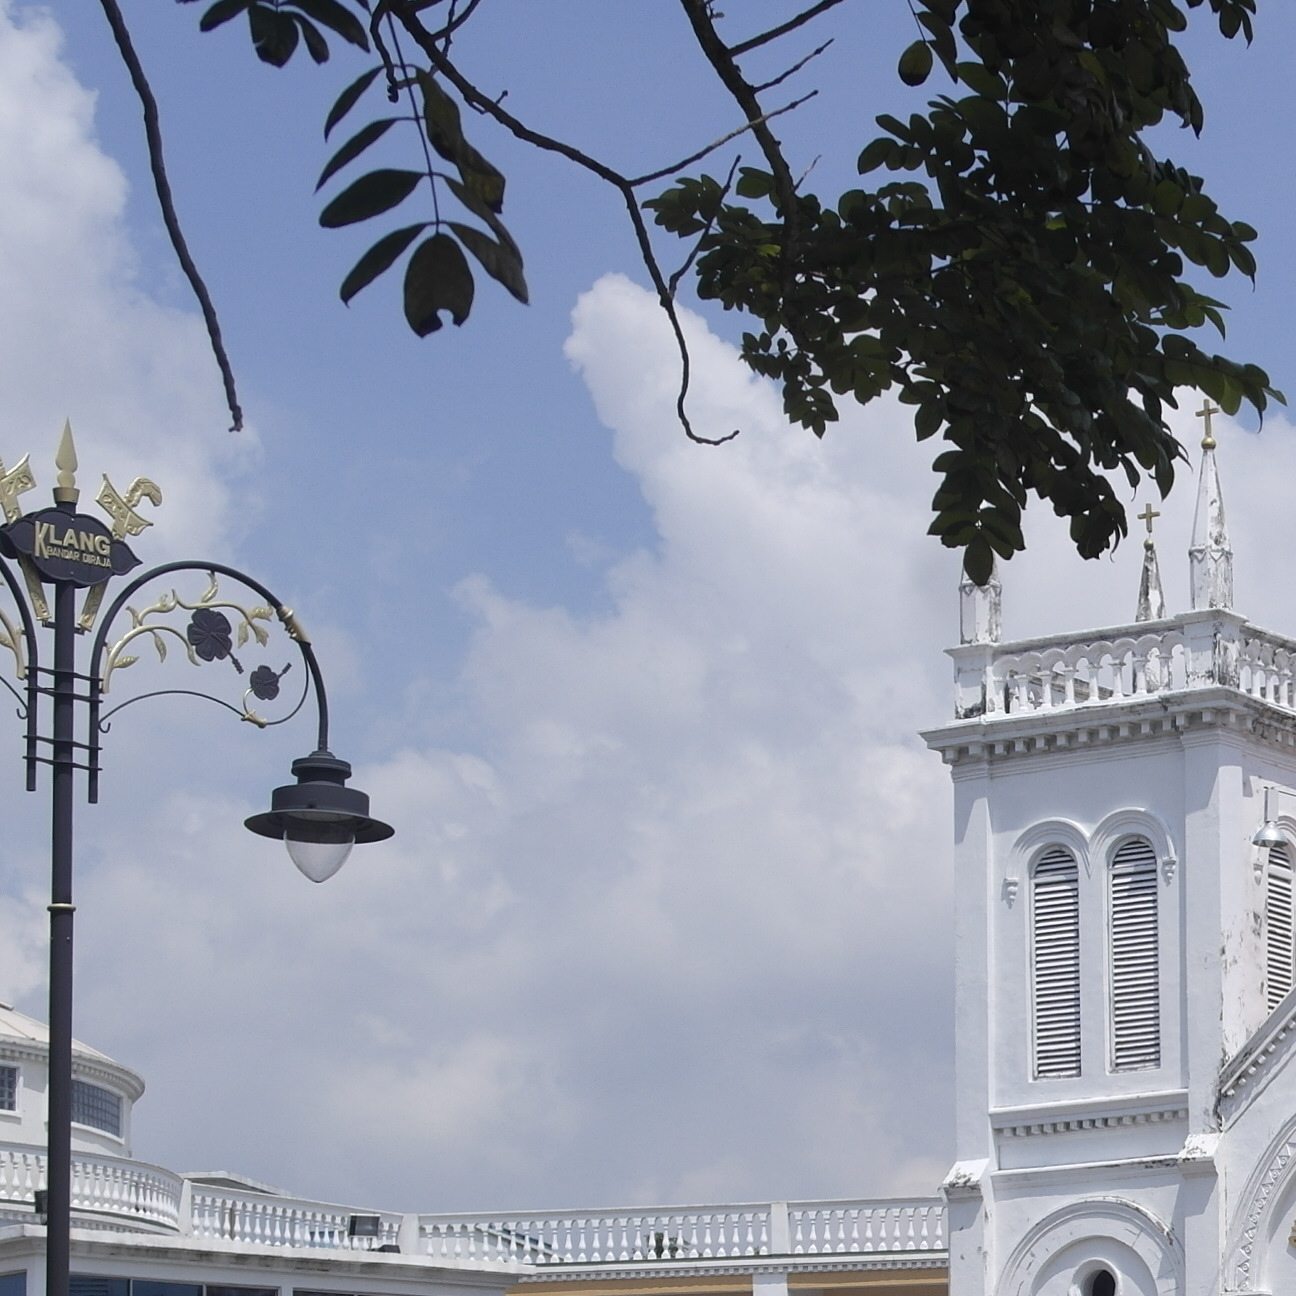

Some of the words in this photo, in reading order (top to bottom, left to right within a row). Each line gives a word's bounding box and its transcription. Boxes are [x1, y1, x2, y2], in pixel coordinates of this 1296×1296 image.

[35, 521, 110, 559] KLANG
[47, 546, 80, 560] BANDAR
[82, 553, 111, 567] DIRAJA
